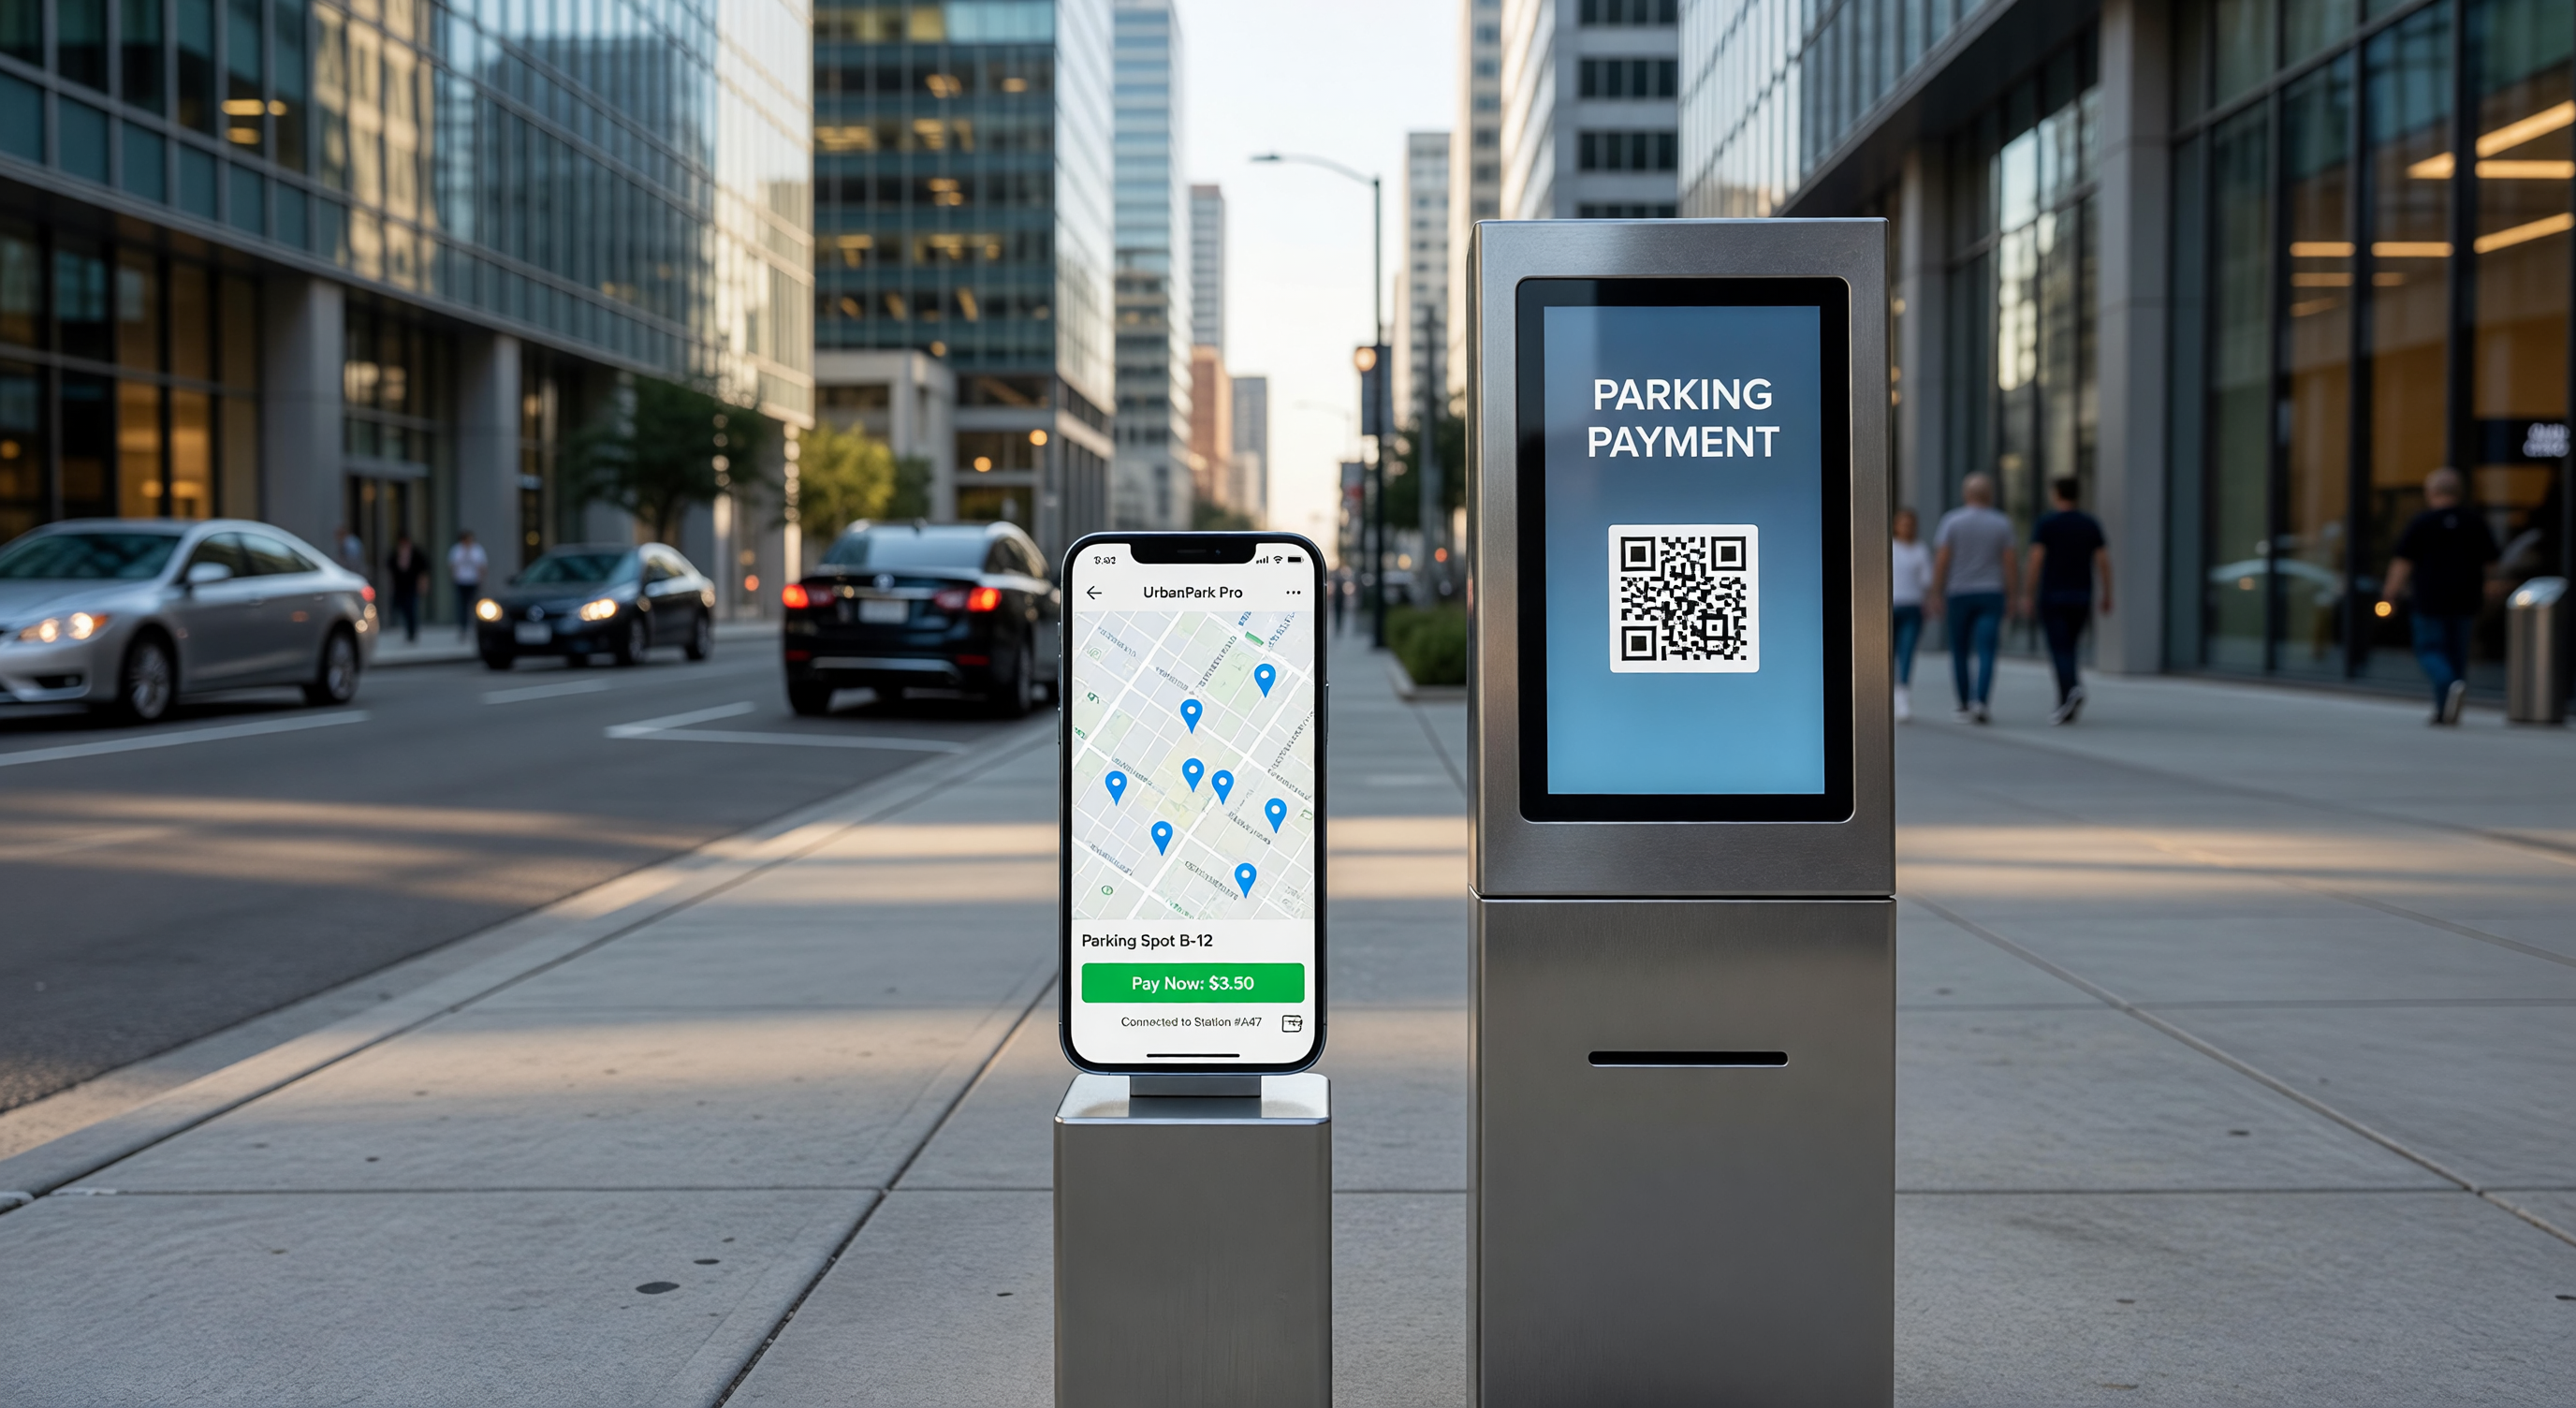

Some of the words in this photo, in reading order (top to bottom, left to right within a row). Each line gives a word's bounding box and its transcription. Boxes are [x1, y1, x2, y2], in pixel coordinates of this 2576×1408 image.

[1594, 377, 1773, 411] PARKING
[1588, 425, 1781, 458] PAYMENT
[1143, 585, 1217, 599] UrbanPark
[1219, 586, 1243, 599] Pro
[1081, 933, 1137, 950] Parking
[1140, 933, 1176, 951] Spot
[1179, 933, 1214, 947] B-12
[1132, 975, 1161, 994] Pay
[1164, 975, 1205, 990] Now:
[1208, 975, 1255, 991] $3.50
[1120, 1016, 1178, 1028] Connected
[1180, 1017, 1193, 1028] to
[1193, 1016, 1232, 1028] Station
[1234, 1016, 1263, 1028] #A47
